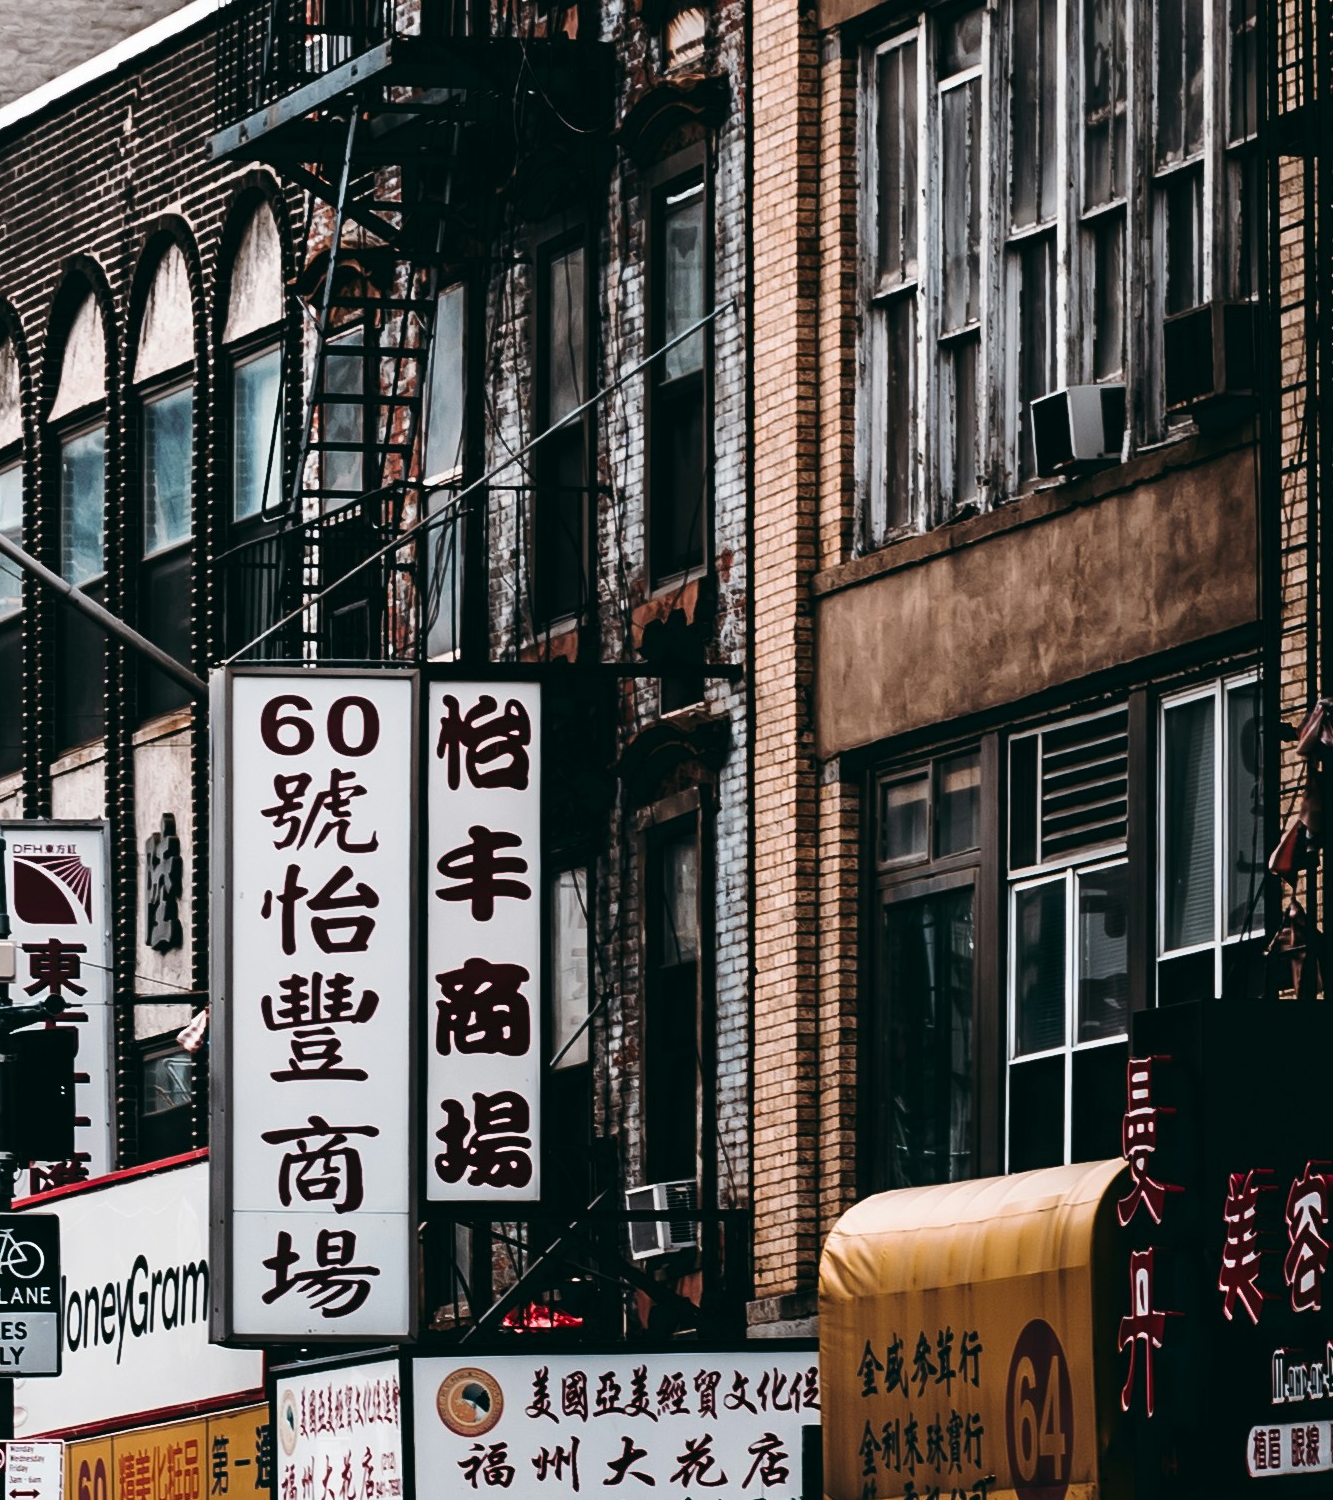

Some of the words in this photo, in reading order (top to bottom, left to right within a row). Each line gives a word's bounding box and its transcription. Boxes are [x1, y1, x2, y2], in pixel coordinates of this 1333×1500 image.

[13, 844, 43, 855] DFH
[61, 1254, 208, 1365] oneyGram
[1013, 1354, 1066, 1482] 64
[457, 1432, 792, 1492] 福州大花店
